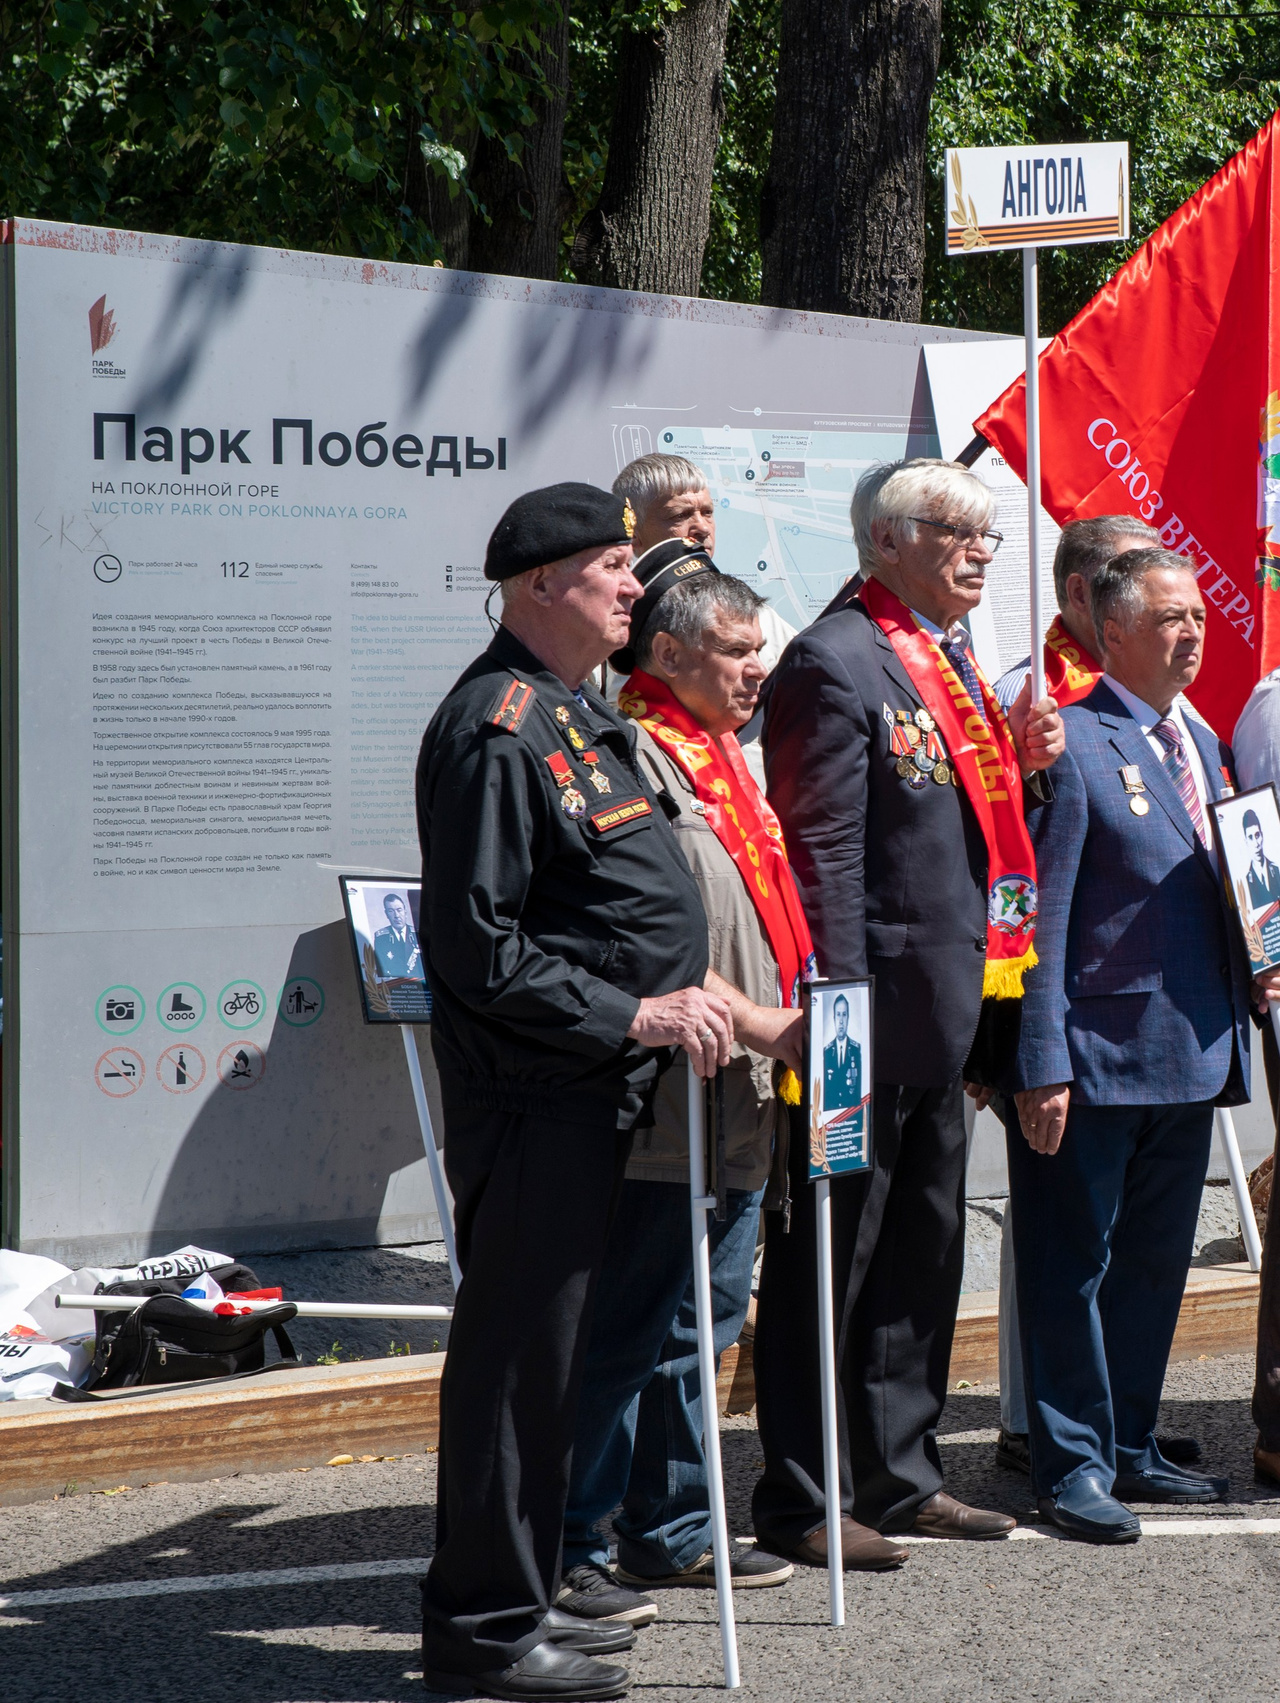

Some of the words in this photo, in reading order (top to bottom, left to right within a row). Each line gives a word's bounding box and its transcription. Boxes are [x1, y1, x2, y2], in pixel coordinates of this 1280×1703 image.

[1001, 157, 1087, 218] АНГОЛА
[92, 367, 126, 375] ПОБЕДЫ
[93, 412, 252, 474] Парк
[272, 418, 508, 477] Победы
[1087, 417, 1165, 520] СОЮЗ
[92, 482, 116, 494] НА
[122, 482, 232, 496] ПОКЛОННОЙ
[239, 485, 279, 498] ГОРЕ
[91, 502, 165, 515] VICTORY
[171, 503, 213, 516] PARK
[219, 504, 242, 517] ON
[249, 505, 359, 518] POKLONNAYA
[364, 507, 408, 519] GORA
[128, 561, 145, 569] Парк
[221, 562, 250, 578] 112
[255, 562, 279, 570] Единый
[299, 563, 323, 571] службы
[351, 592, 419, 600] info@poklonnaya-gora.ru
[92, 613, 113, 622] Идея
[115, 614, 152, 622] создания
[315, 615, 332, 623] горе
[158, 626, 177, 635] году,
[202, 625, 224, 633] Союз
[278, 625, 299, 633] СССР
[92, 638, 124, 646] конкурс
[139, 637, 169, 646] лучший
[171, 638, 198, 646] проект
[232, 637, 263, 646] Победы
[155, 648, 194, 657] (1941–1945
[196, 649, 208, 658] гг.).
